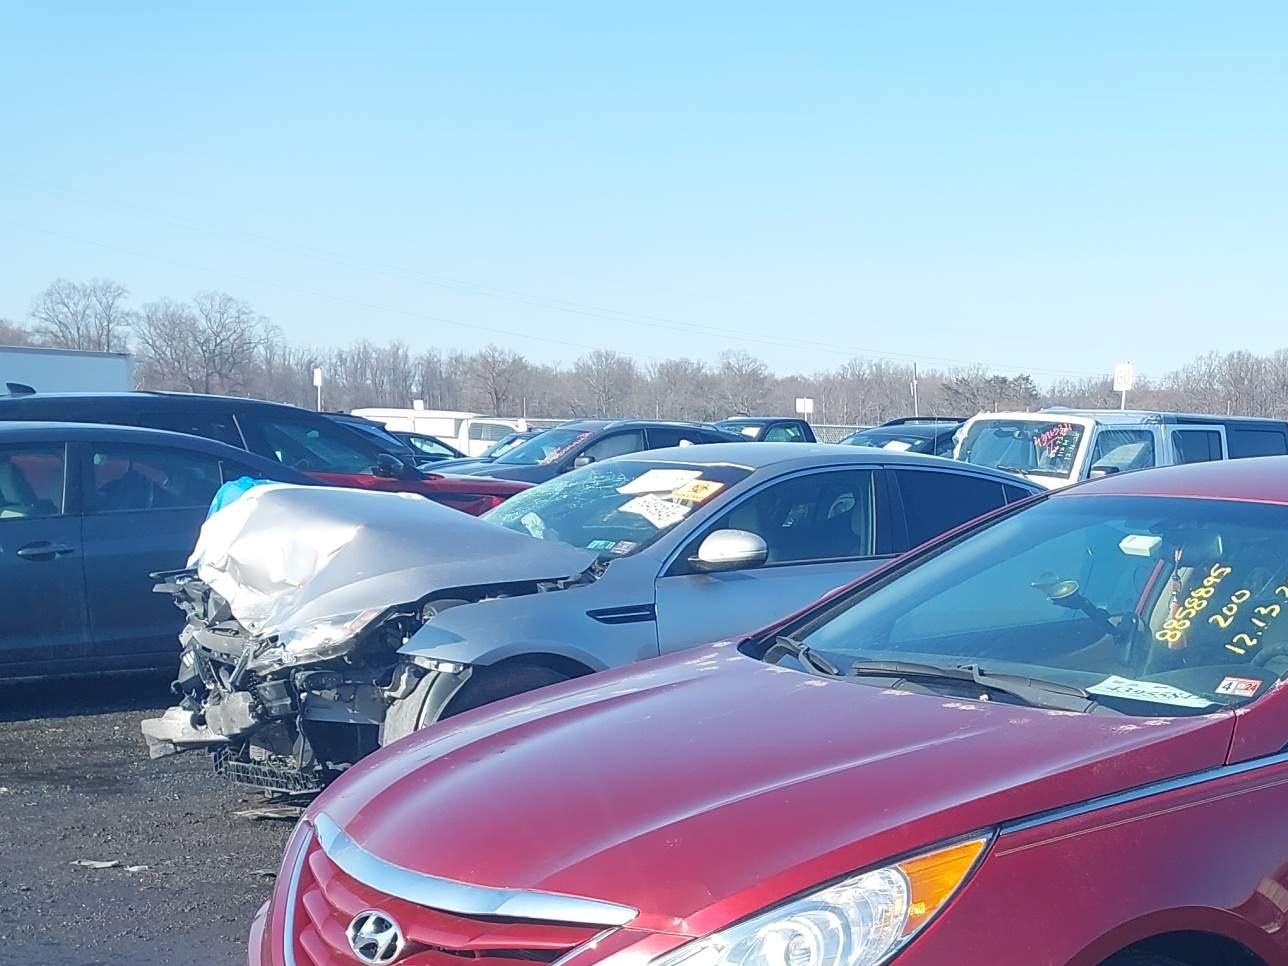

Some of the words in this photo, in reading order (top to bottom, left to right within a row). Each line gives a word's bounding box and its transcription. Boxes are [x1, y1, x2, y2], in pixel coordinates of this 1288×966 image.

[1156, 563, 1232, 642] 8858895
[1209, 589, 1251, 628] 200
[1222, 681, 1234, 691] 4
